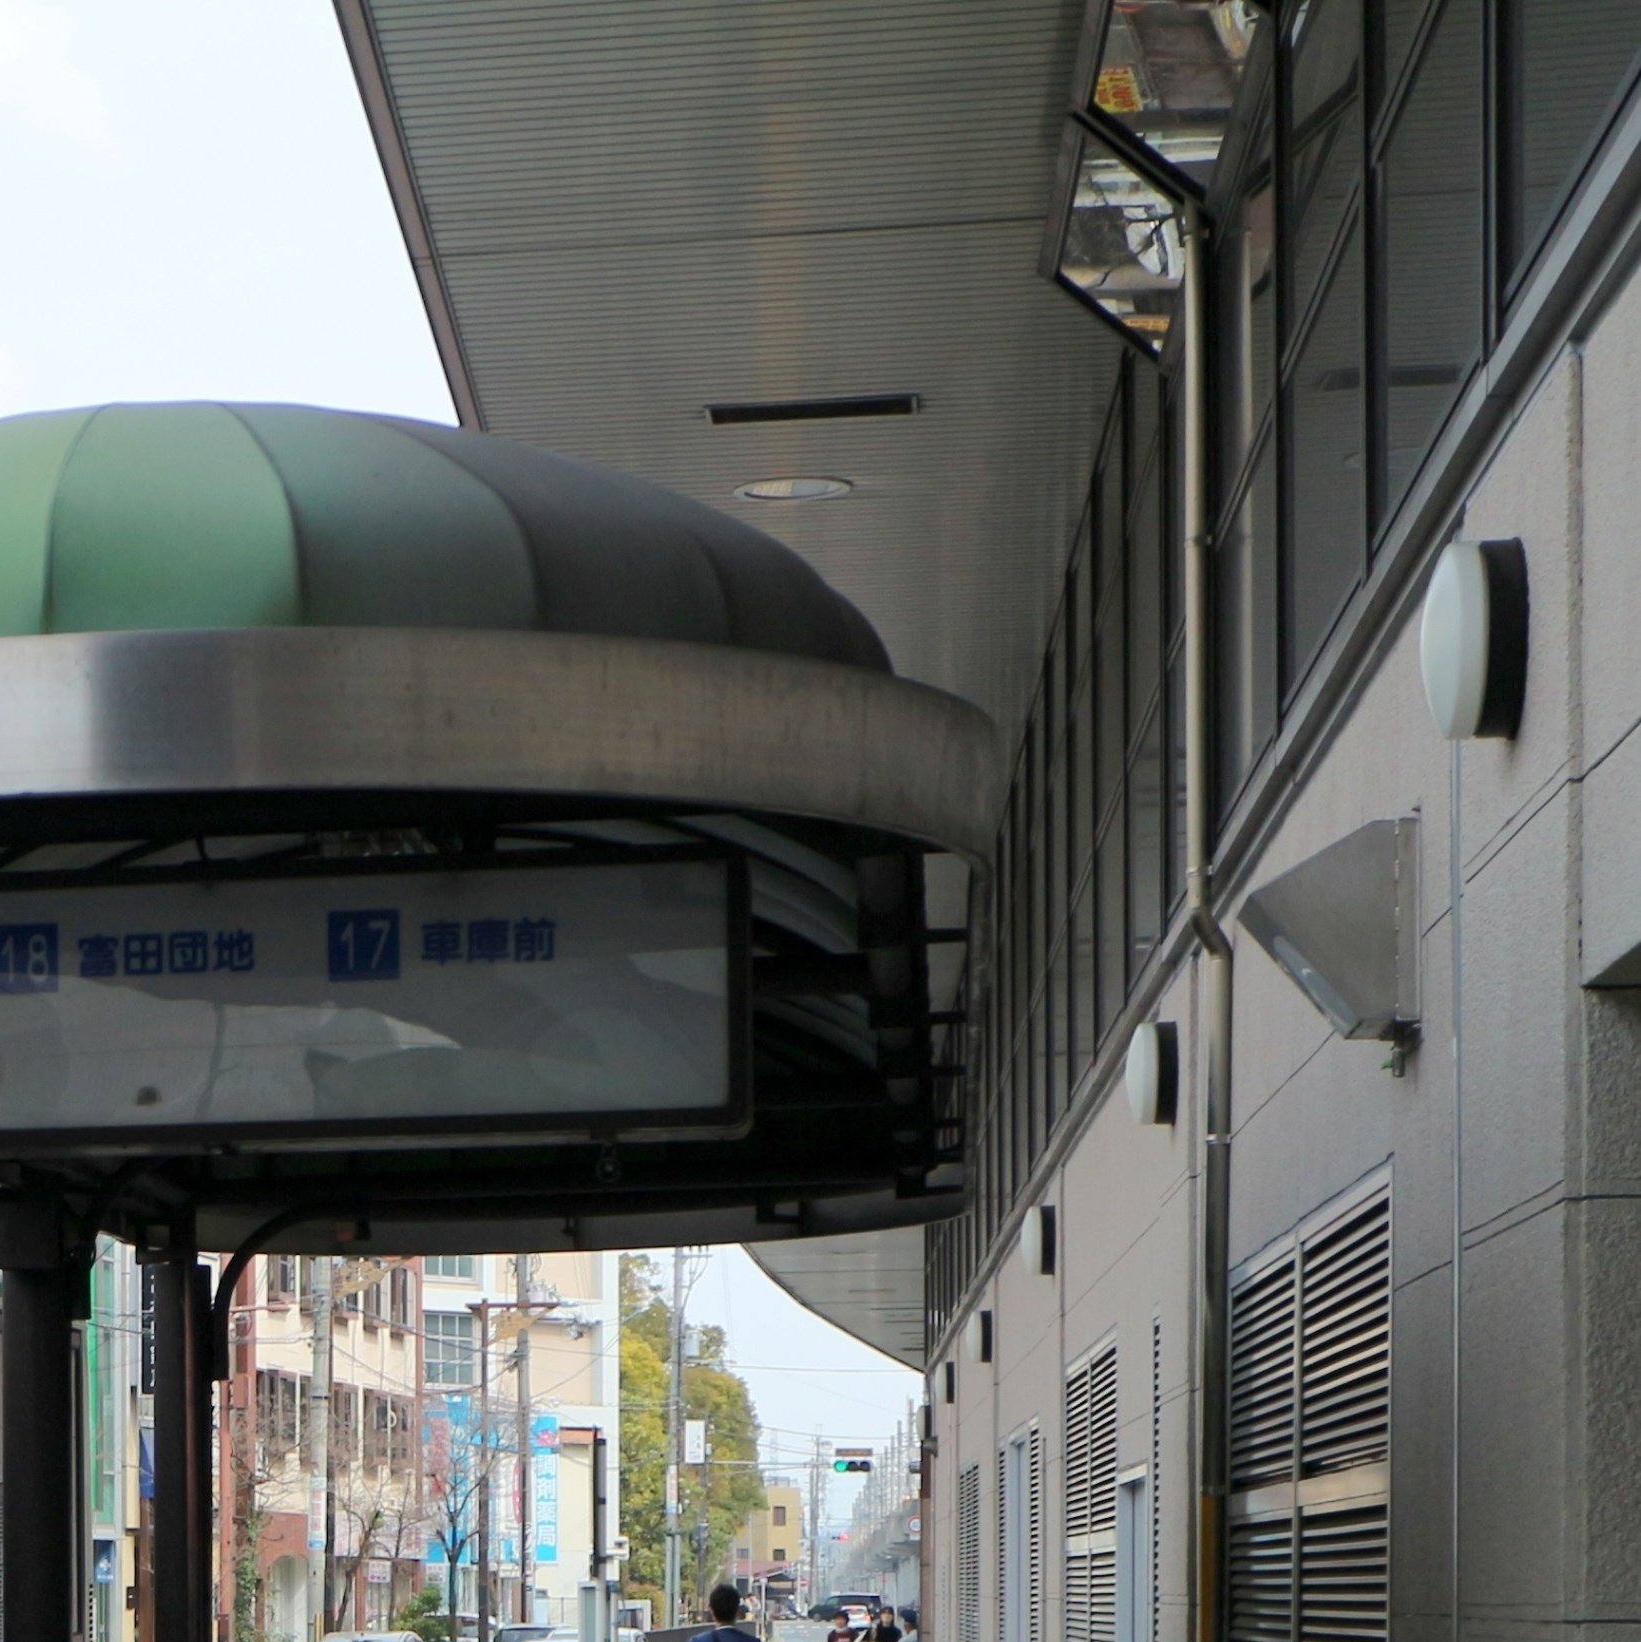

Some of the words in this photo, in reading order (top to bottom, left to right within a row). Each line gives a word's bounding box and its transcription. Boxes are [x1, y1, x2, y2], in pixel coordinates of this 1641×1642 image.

[0, 936, 50, 988] 18
[76, 930, 256, 978] 富田団地
[340, 920, 391, 971] 17
[420, 917, 557, 967] 車庫前
[536, 1455, 557, 1547] 調剤薬局
